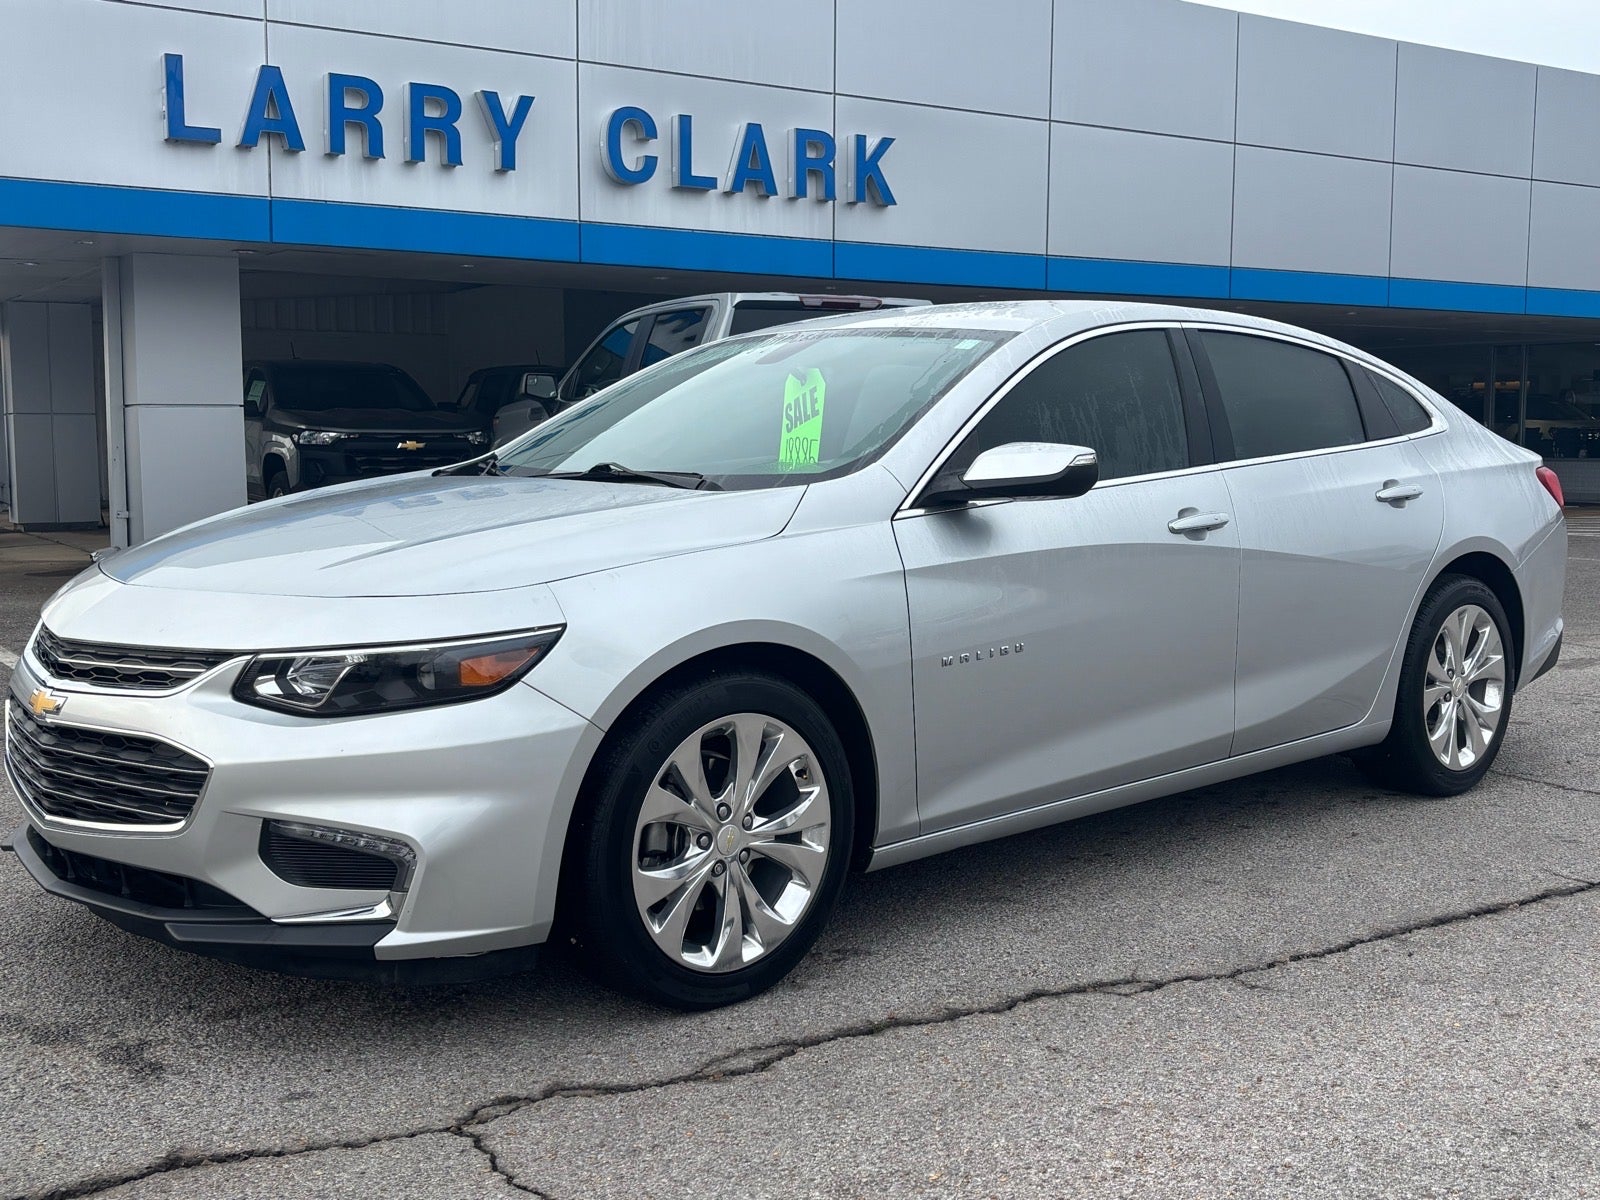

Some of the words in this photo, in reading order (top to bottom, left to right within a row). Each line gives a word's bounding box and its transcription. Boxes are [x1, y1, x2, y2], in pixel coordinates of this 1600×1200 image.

[162, 54, 535, 172] LARRY
[601, 106, 897, 206] CLARK
[785, 387, 819, 433] SALE
[941, 642, 1024, 667] MALIBU
